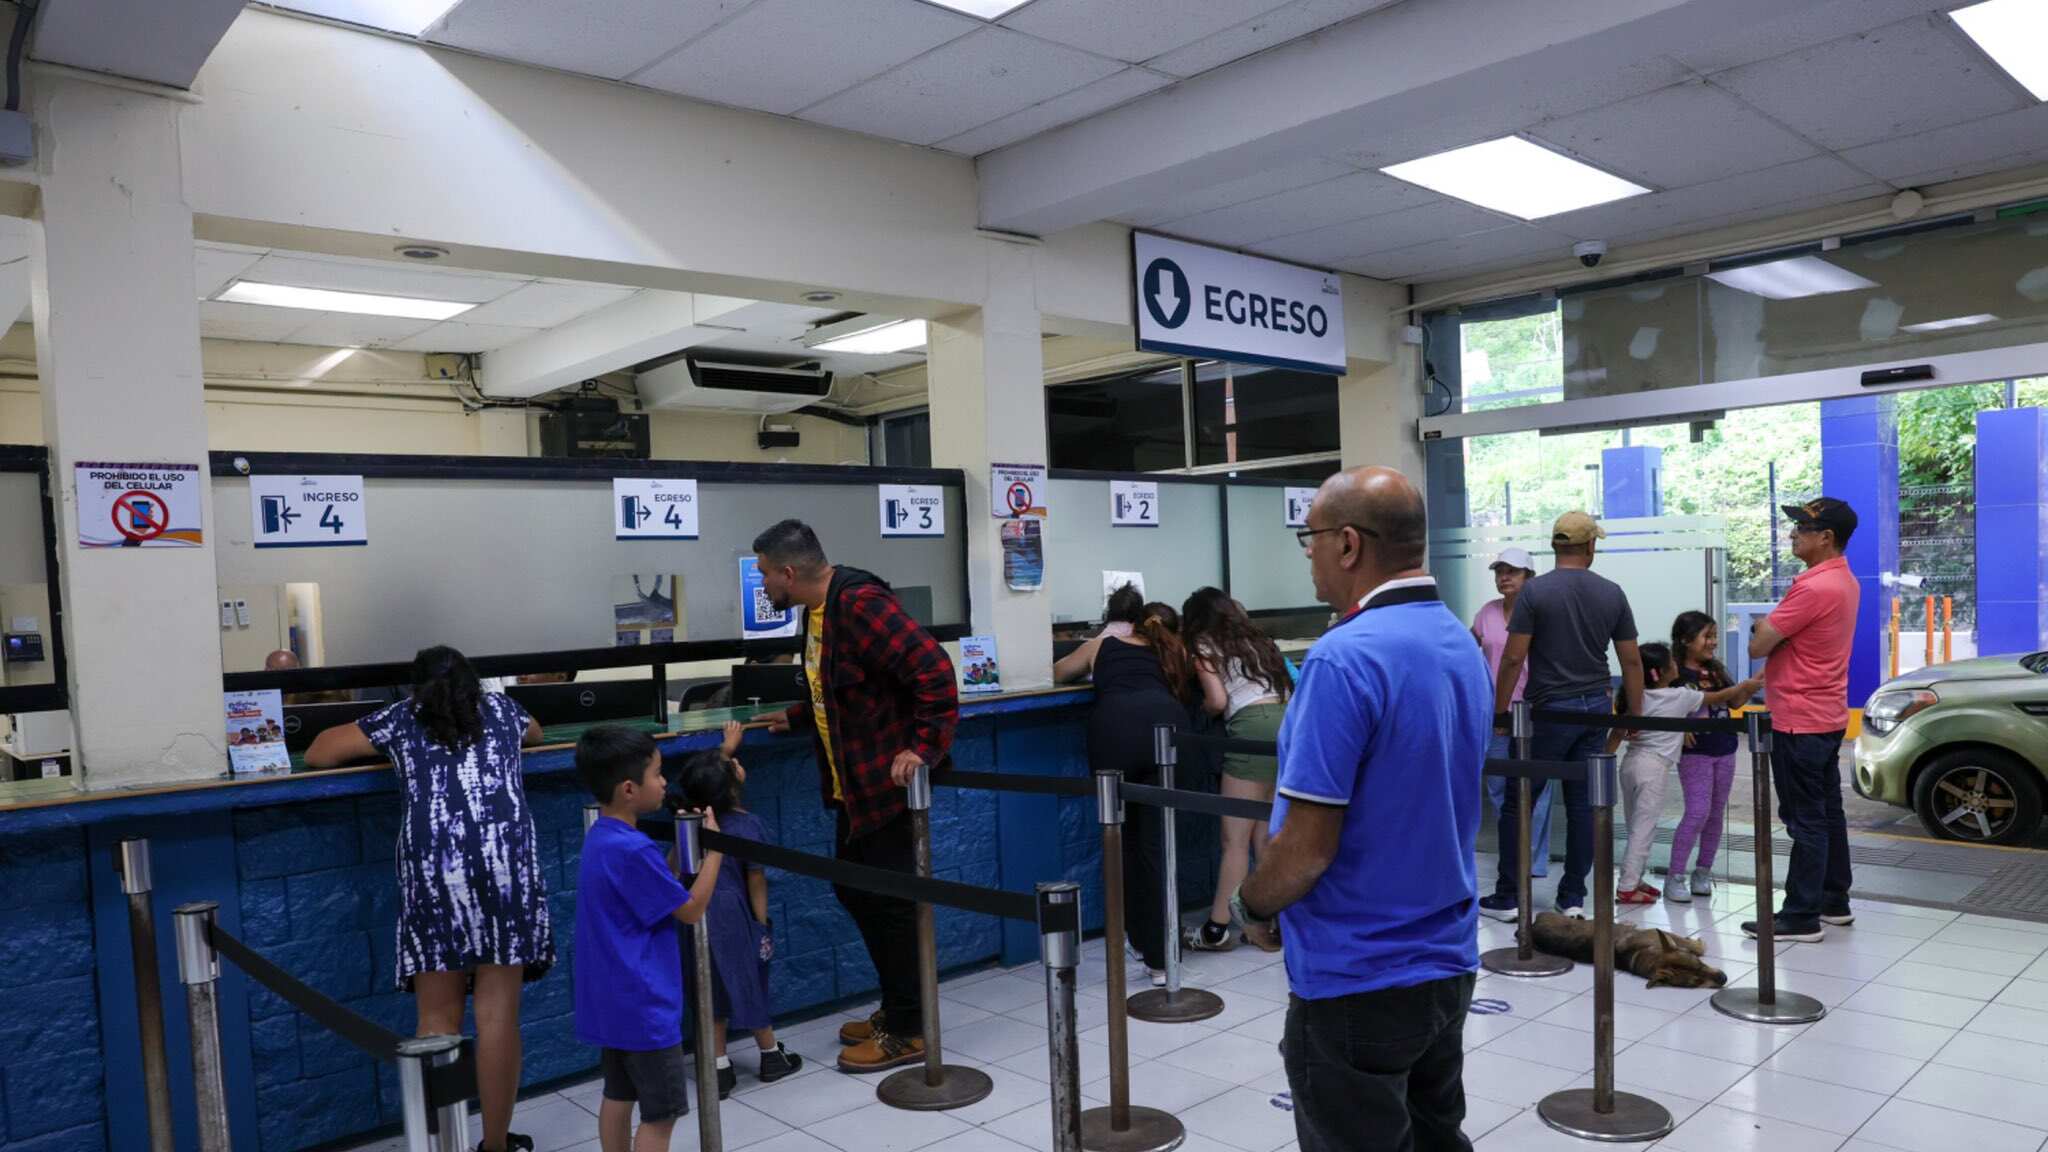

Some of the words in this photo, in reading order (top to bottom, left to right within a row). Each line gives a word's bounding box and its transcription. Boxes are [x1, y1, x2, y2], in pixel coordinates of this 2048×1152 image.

[1204, 284, 1328, 338] EGRESO
[89, 471, 147, 481] PROHIBIDO
[149, 472, 161, 482] EL
[163, 473, 185, 482] USO
[104, 481, 125, 490] DEL
[126, 481, 173, 490] CELULAR
[303, 492, 359, 502] INGRESO
[654, 494, 692, 502] EGRESO
[910, 497, 939, 505] EGRESO
[664, 504, 682, 530] 4
[918, 506, 933, 529] 3
[1139, 500, 1150, 520] 2
[319, 504, 344, 534] 4
